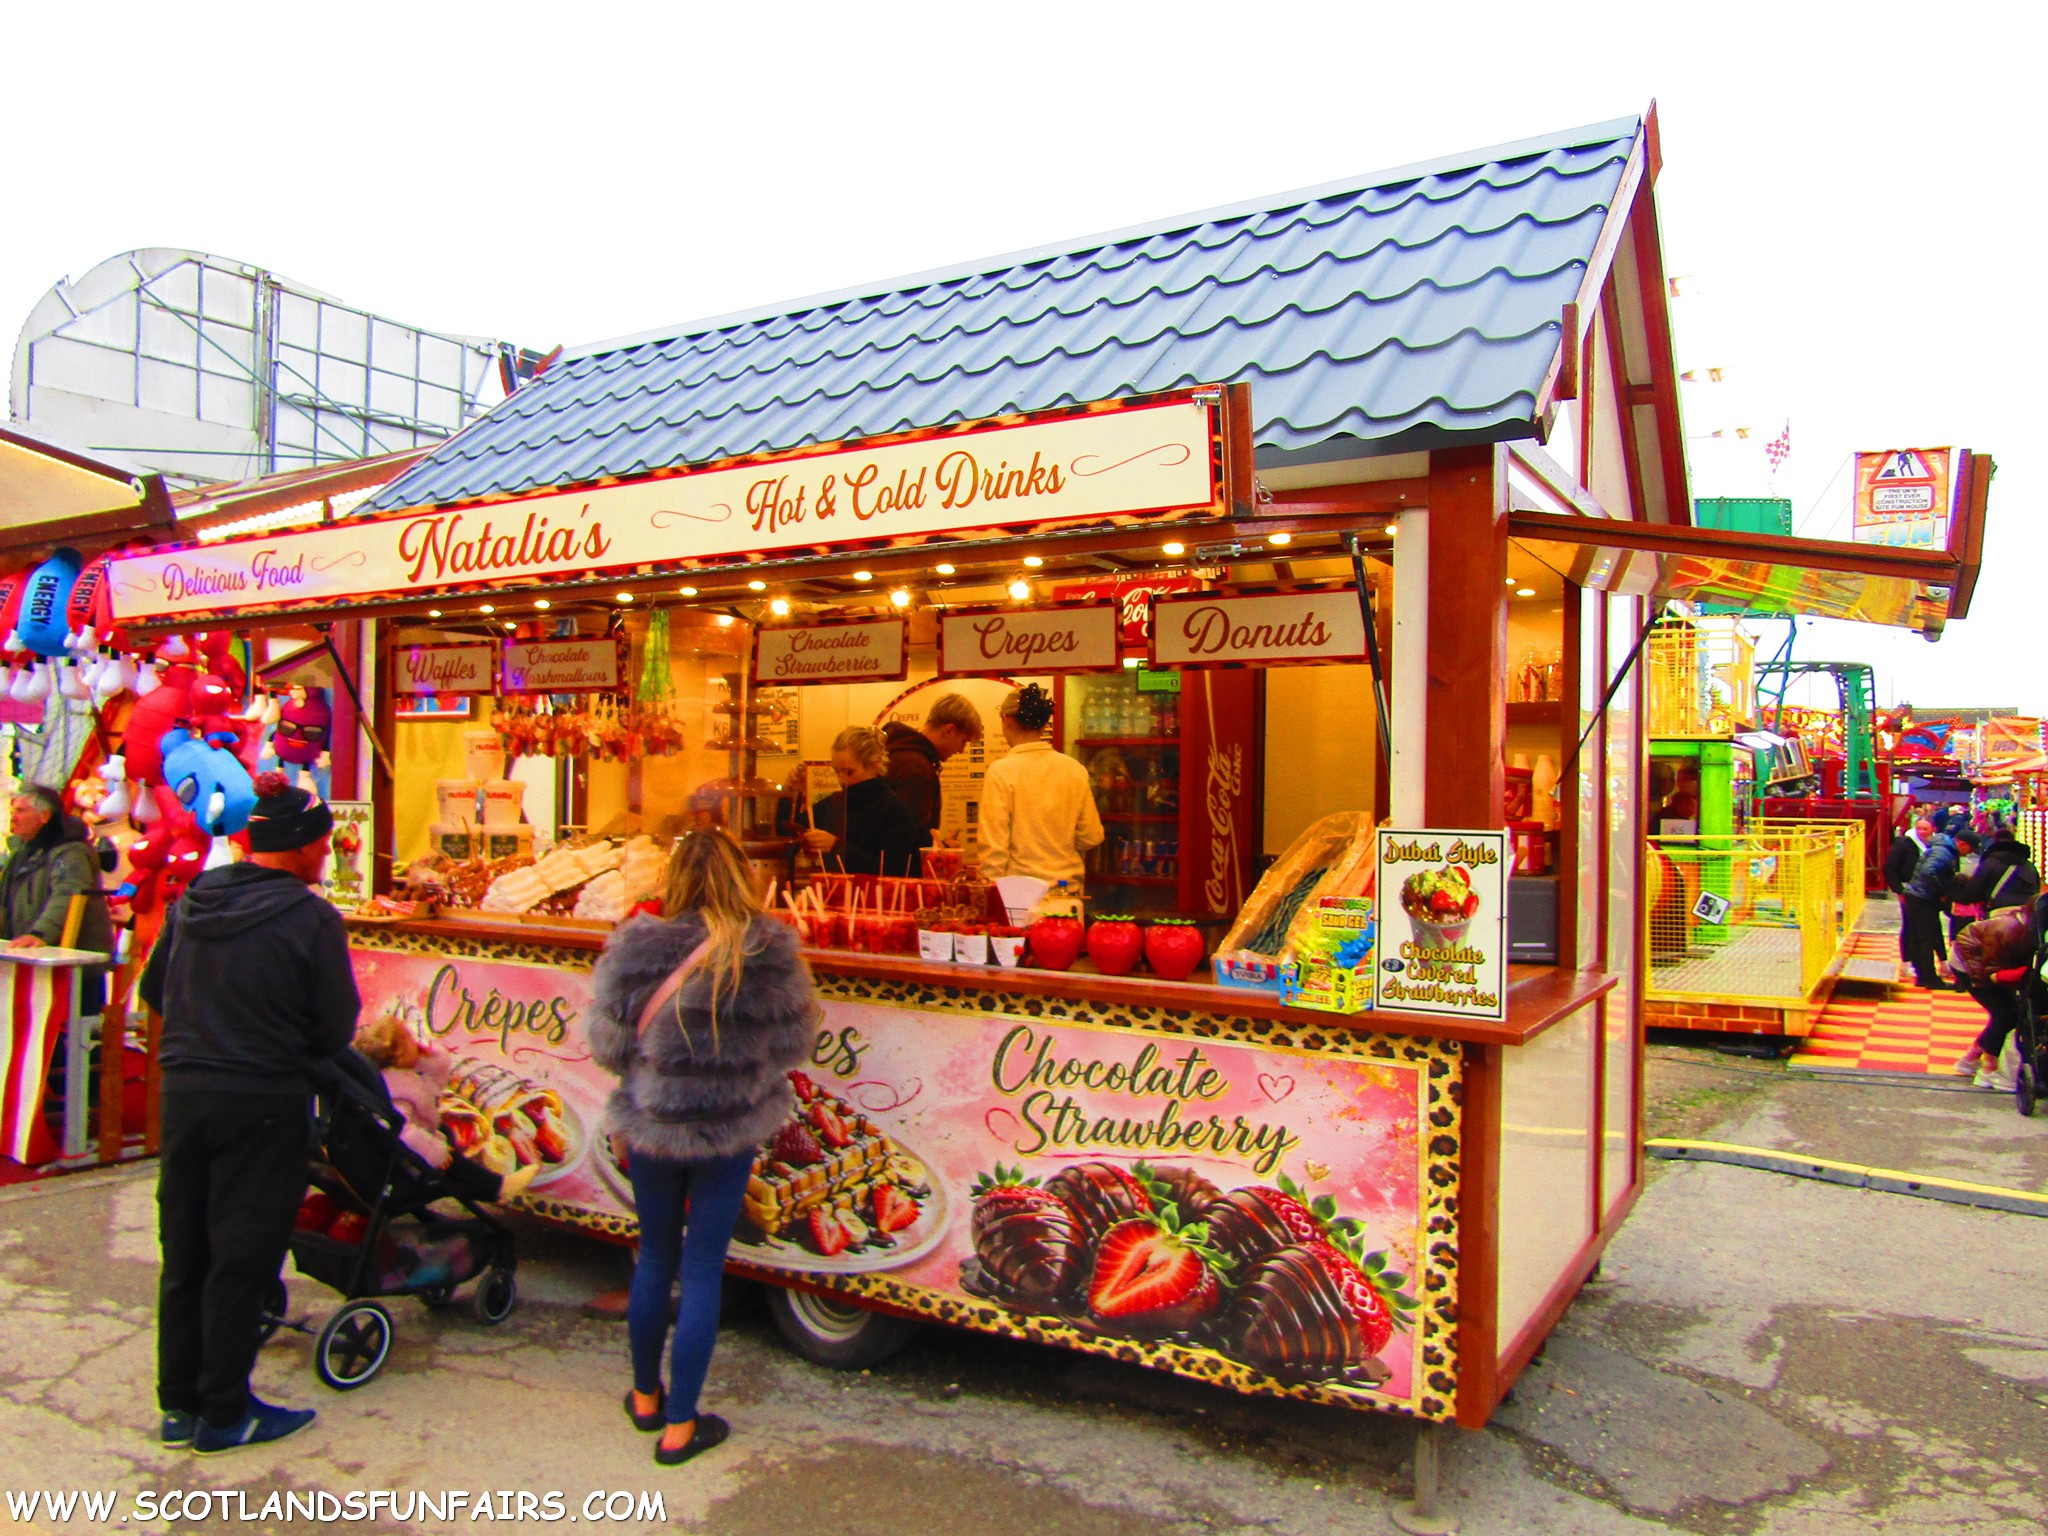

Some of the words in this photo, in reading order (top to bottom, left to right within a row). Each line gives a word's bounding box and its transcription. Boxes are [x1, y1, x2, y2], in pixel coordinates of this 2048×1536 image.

[746, 474, 806, 533] Hot
[815, 474, 836, 520] &
[844, 463, 927, 521] Cold
[935, 450, 1066, 510] Drinks
[399, 504, 611, 583] Natalia's
[162, 562, 247, 602] Delicious
[252, 549, 304, 592] Food
[29, 575, 59, 625] ENERGY
[789, 630, 870, 653] Chocolate
[973, 617, 1079, 665] Crepes
[1183, 606, 1331, 655] Donuts
[407, 653, 477, 689] Waffles
[526, 646, 589, 665] Chocolate
[775, 652, 881, 677] Strawberries
[512, 667, 607, 686] Marshmallows
[1383, 836, 1442, 864] Dubai
[1446, 838, 1498, 869] Style
[1347, 914, 1367, 929] GEL
[1400, 940, 1485, 963] Chocolate
[1406, 961, 1477, 985] Covered
[425, 964, 578, 1056] Crêpes
[1382, 976, 1497, 1008] Strawberries
[992, 1025, 1229, 1099] Chocolate
[1015, 1091, 1299, 1175] Strawberry
